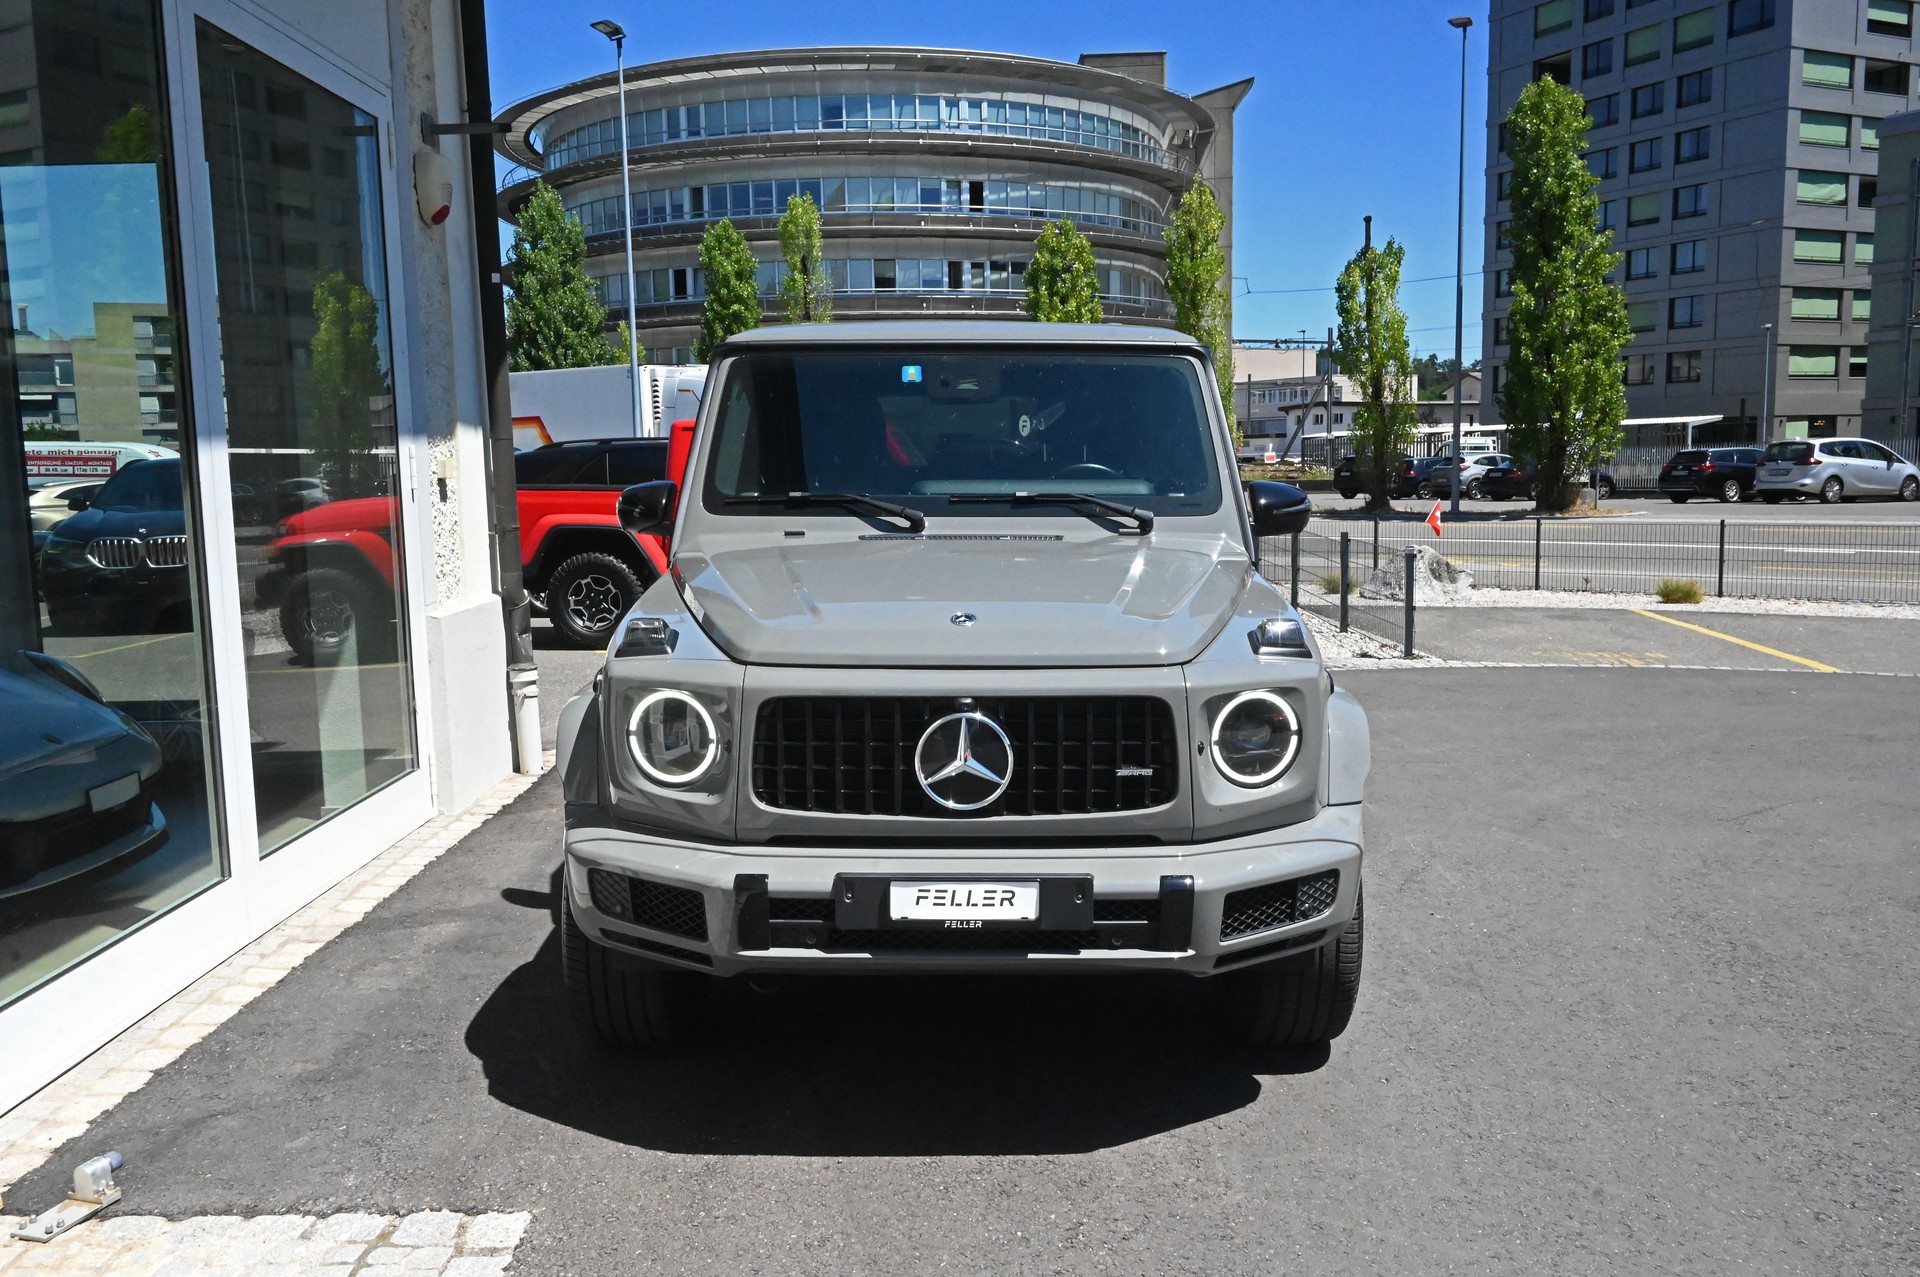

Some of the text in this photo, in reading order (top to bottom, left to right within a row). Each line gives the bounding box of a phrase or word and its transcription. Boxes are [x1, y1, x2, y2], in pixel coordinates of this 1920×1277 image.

[77, 449, 121, 457] günstig!
[915, 888, 1016, 907] FELLER
[944, 920, 983, 929] FELLER
